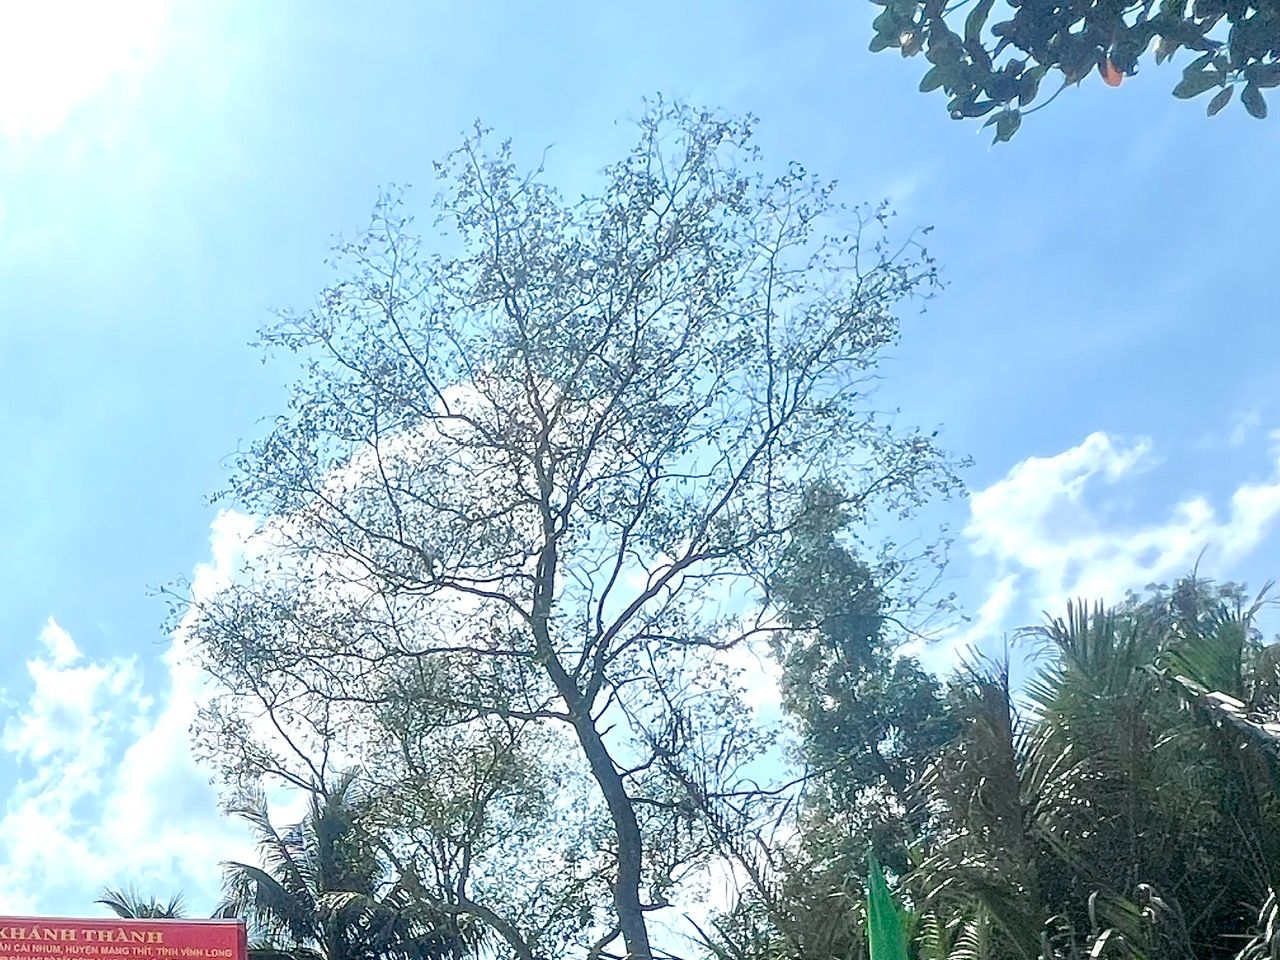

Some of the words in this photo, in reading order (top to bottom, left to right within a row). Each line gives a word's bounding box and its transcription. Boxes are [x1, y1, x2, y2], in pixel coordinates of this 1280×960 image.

[81, 928, 164, 944] THÀNH
[14, 942, 30, 952] CÁI
[32, 944, 64, 954] NHUM,
[66, 945, 98, 956] HUYỆN
[100, 946, 130, 955] MANG
[156, 946, 178, 956] TỈNH
[180, 946, 203, 956] VĨNH
[205, 948, 232, 958] LONG
